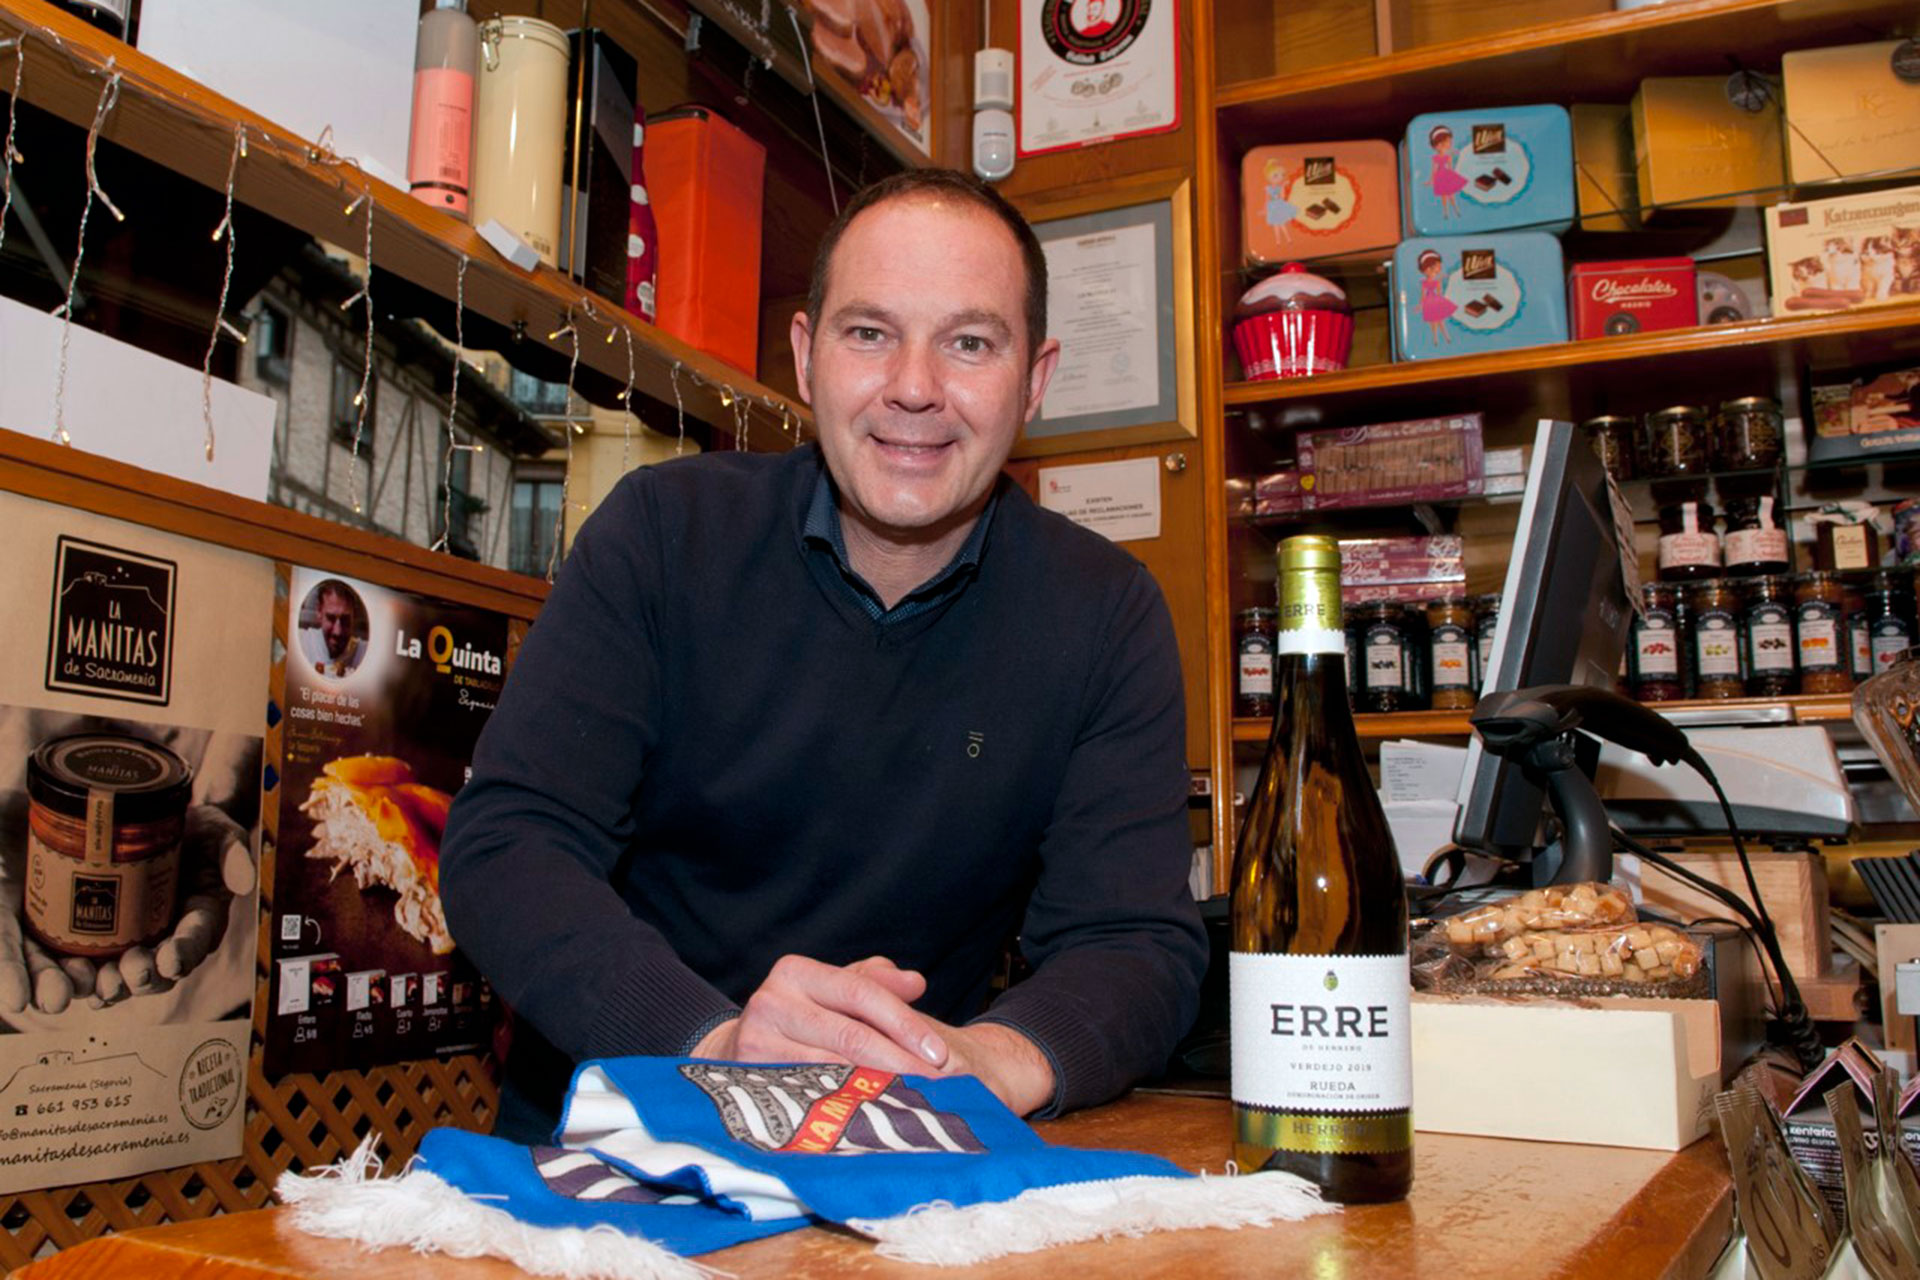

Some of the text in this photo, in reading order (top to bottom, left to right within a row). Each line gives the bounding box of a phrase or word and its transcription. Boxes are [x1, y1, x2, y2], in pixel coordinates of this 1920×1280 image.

[1591, 278, 1678, 303] Chocolates
[109, 600, 121, 620] LA
[1284, 603, 1325, 617] ERRE
[67, 615, 158, 667] MANITAS
[396, 625, 501, 675] La Quinta
[64, 658, 156, 687] de Sacramenia
[316, 708, 333, 722] bien
[1270, 1003, 1389, 1038] ERRE
[1290, 1062, 1344, 1072] VERDEJO
[29, 1076, 132, 1095] Sacramenia (Segovia)
[1310, 1081, 1356, 1091] RUEDA
[37, 1094, 132, 1115] 661 953 615
